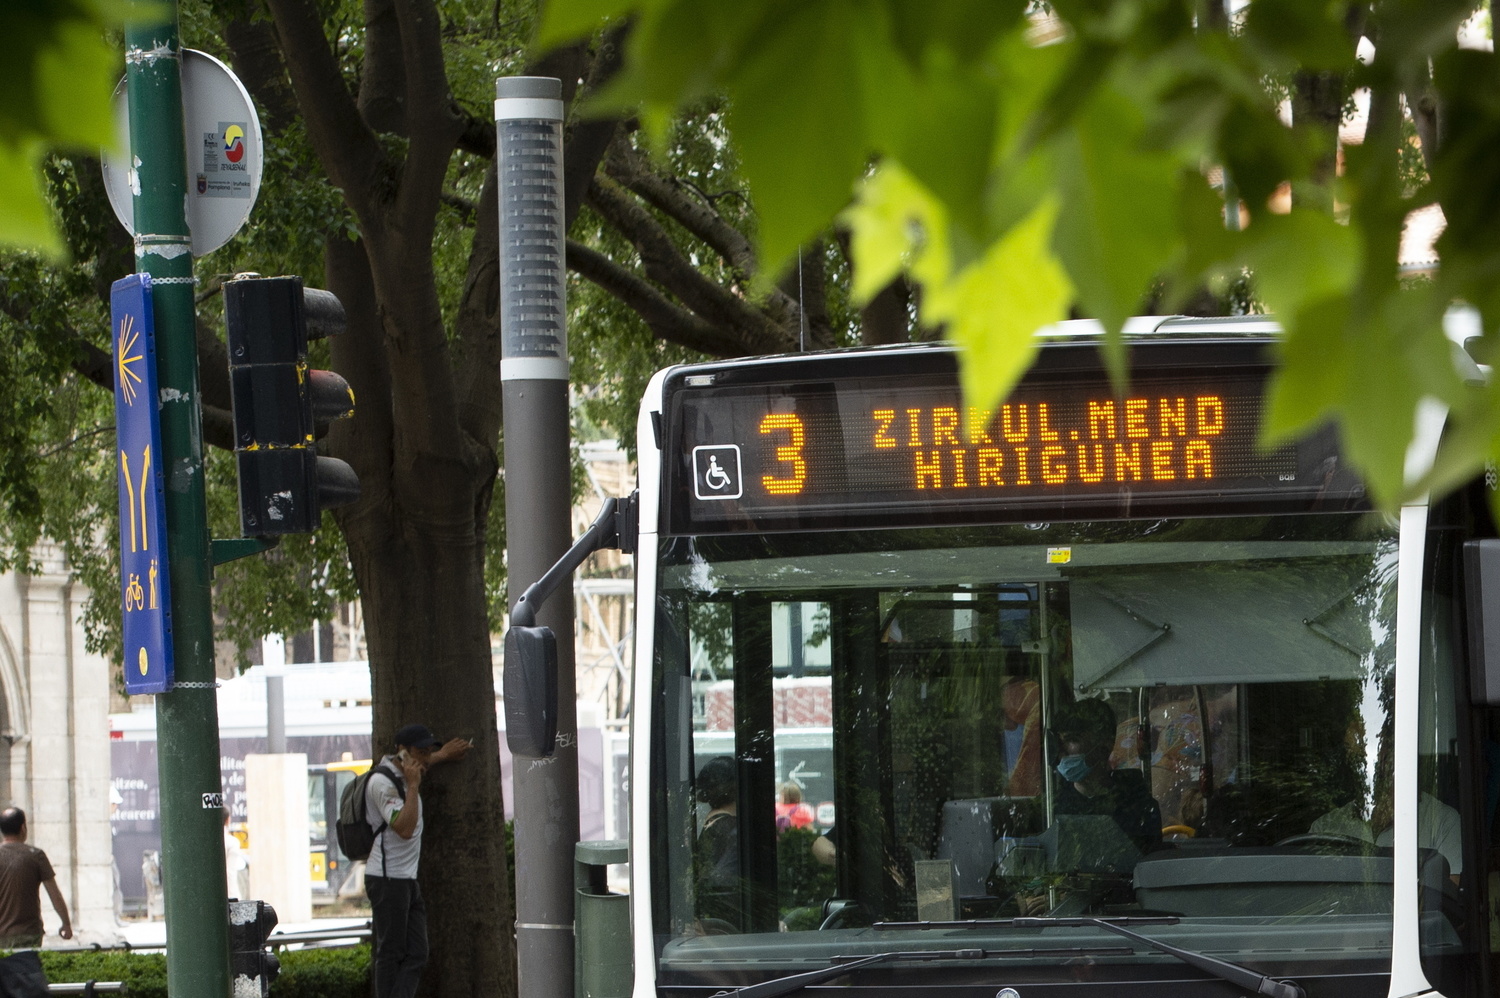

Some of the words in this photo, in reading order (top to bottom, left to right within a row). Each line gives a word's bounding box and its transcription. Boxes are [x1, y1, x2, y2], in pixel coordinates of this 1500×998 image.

[872, 396, 1224, 448] ZIRKUL.MEND
[760, 413, 805, 494] 3
[915, 440, 1213, 489] HIRIGUNEA
[229, 771, 244, 786] de
